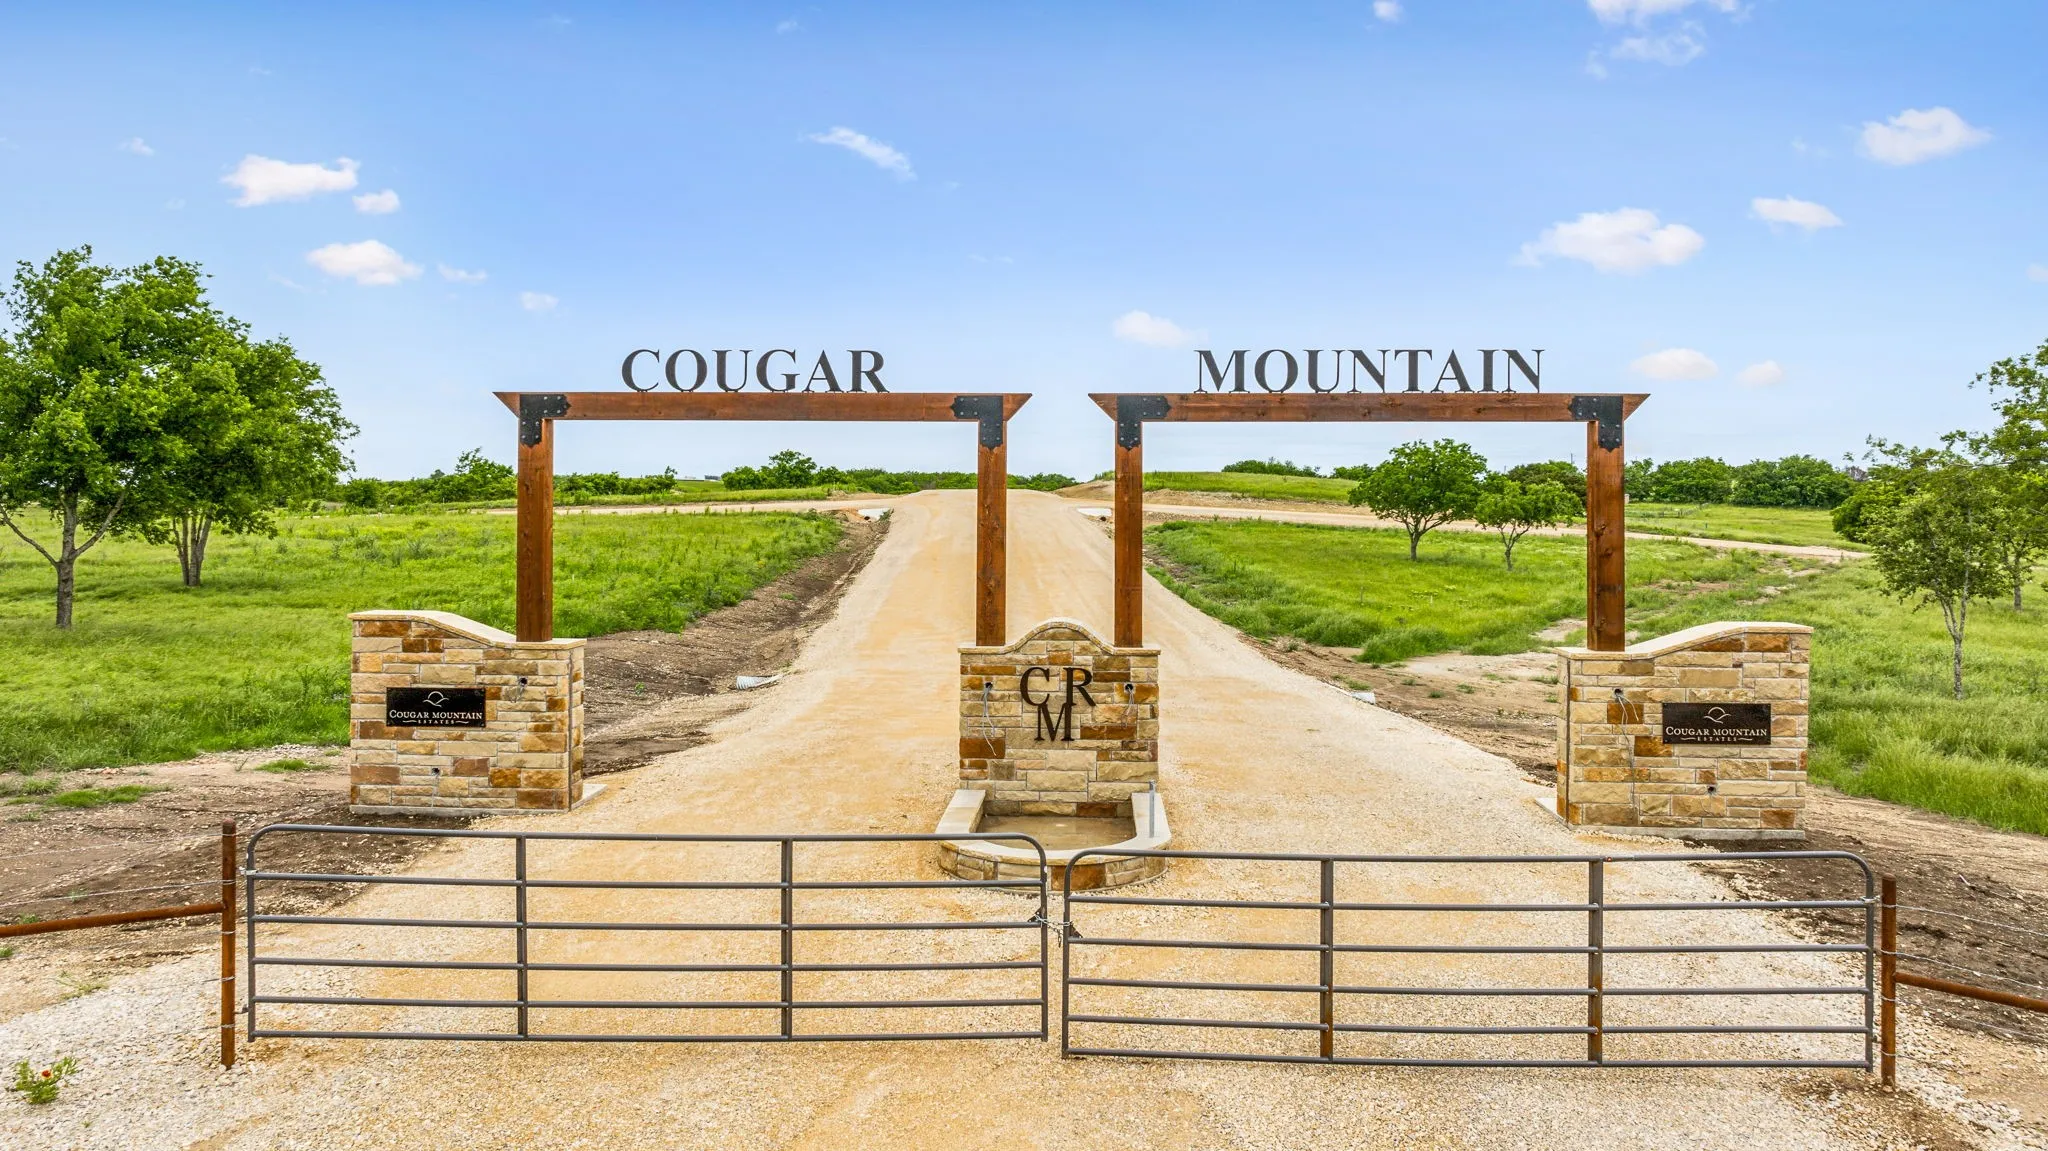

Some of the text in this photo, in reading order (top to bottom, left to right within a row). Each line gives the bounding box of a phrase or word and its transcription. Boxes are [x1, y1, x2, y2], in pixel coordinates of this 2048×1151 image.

[621, 349, 890, 393] COUGAR
[1194, 349, 1546, 393] MOUNTAIN
[389, 709, 483, 720] COUGAR MOUNTAIN
[1665, 726, 1768, 736] COUGAR MOUNTAIN
